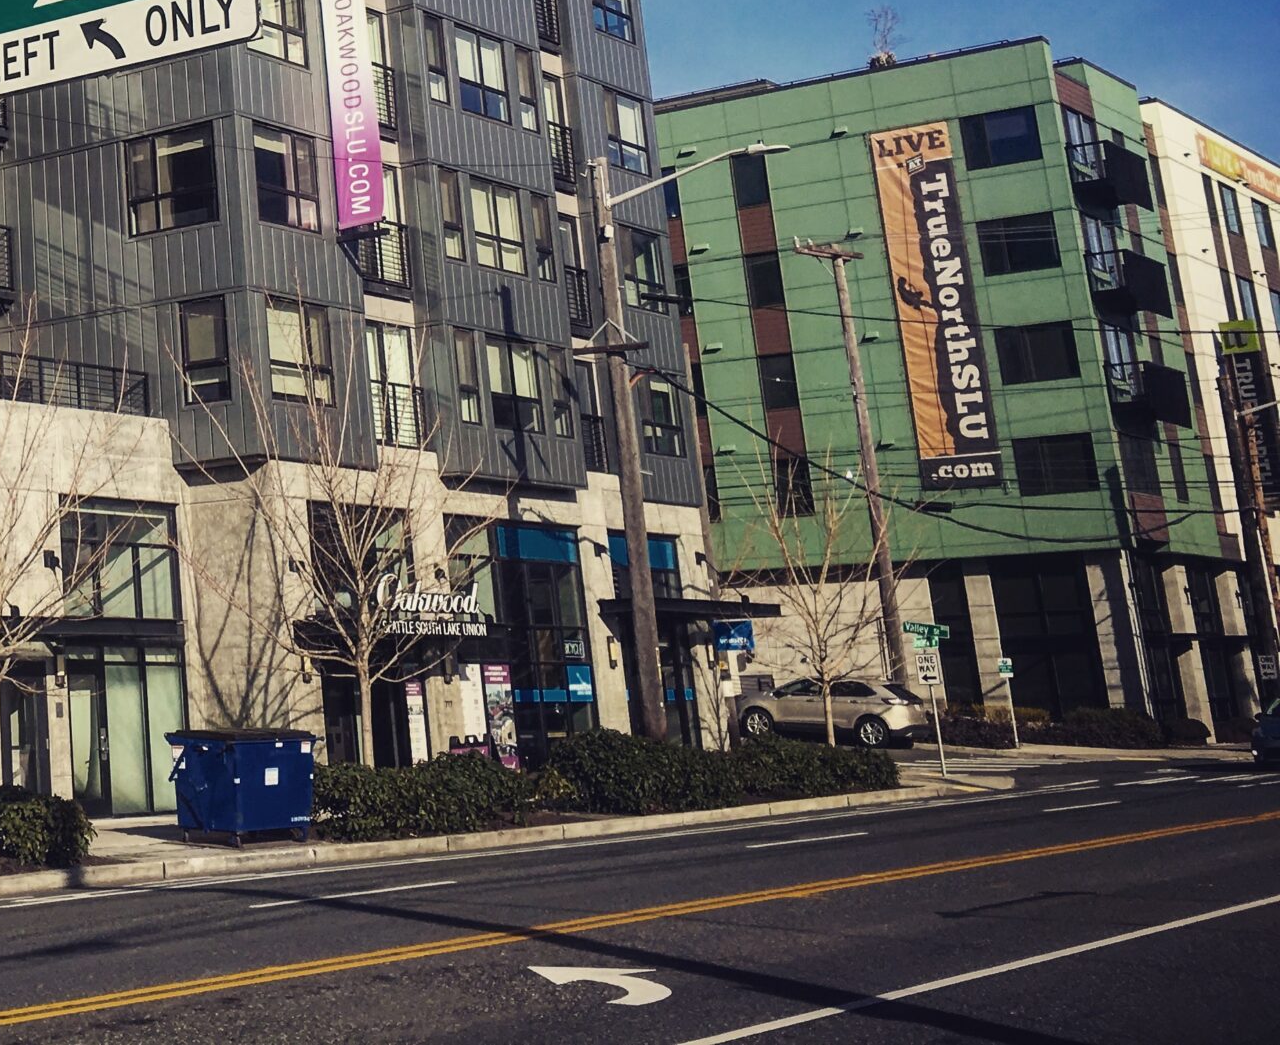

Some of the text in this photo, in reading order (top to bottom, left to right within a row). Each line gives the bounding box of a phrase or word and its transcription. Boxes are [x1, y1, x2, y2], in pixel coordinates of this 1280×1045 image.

[876, 129, 946, 158] LIVE
[907, 158, 923, 170] AT
[920, 172, 990, 440] TrueNorthSLU
[931, 462, 995, 480] .com
[376, 573, 480, 614] Oakwood
[415, 621, 442, 636] SOUTH
[443, 622, 461, 636] LAKE
[462, 623, 488, 637] UNION
[905, 621, 929, 637] Valley
[917, 656, 935, 664] ONE
[918, 665, 936, 673] WAY
